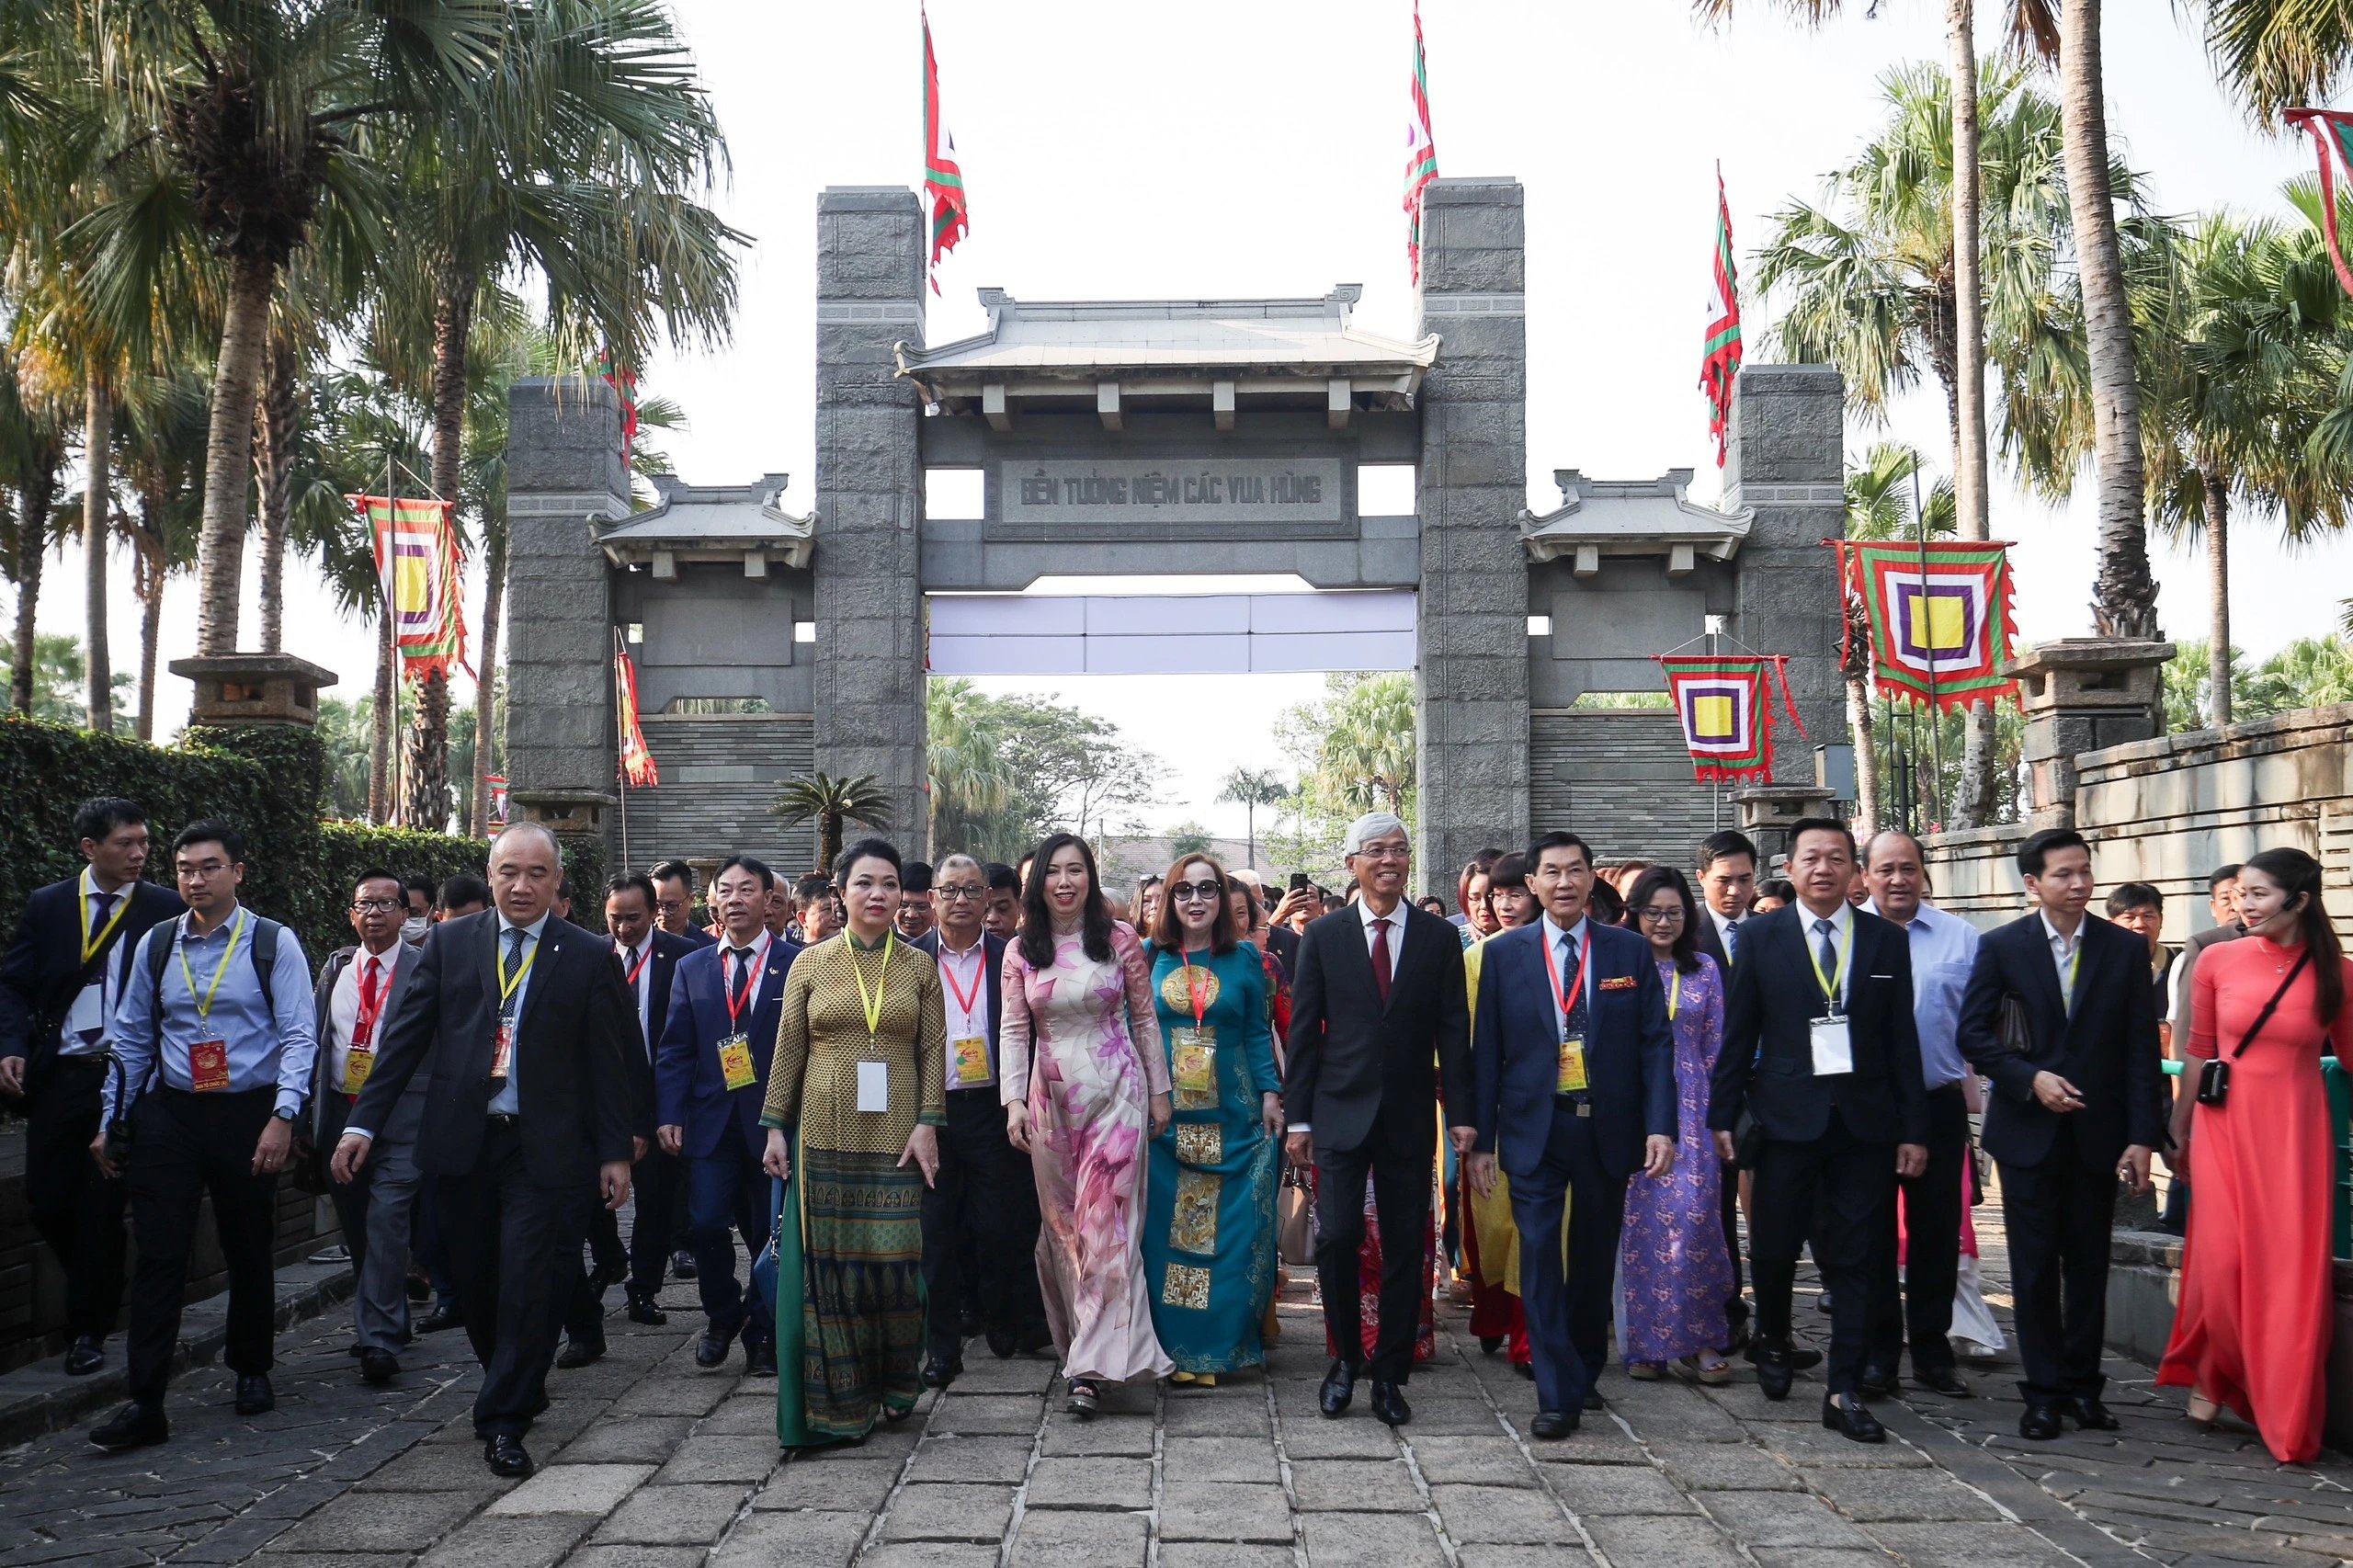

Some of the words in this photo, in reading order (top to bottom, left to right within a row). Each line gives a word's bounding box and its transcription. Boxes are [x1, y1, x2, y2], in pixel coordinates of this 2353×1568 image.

[1131, 470, 1179, 508] NIỆM
[1184, 471, 1222, 505] CÁC
[1226, 476, 1266, 505] VUA
[1269, 470, 1322, 505] HÙNG
